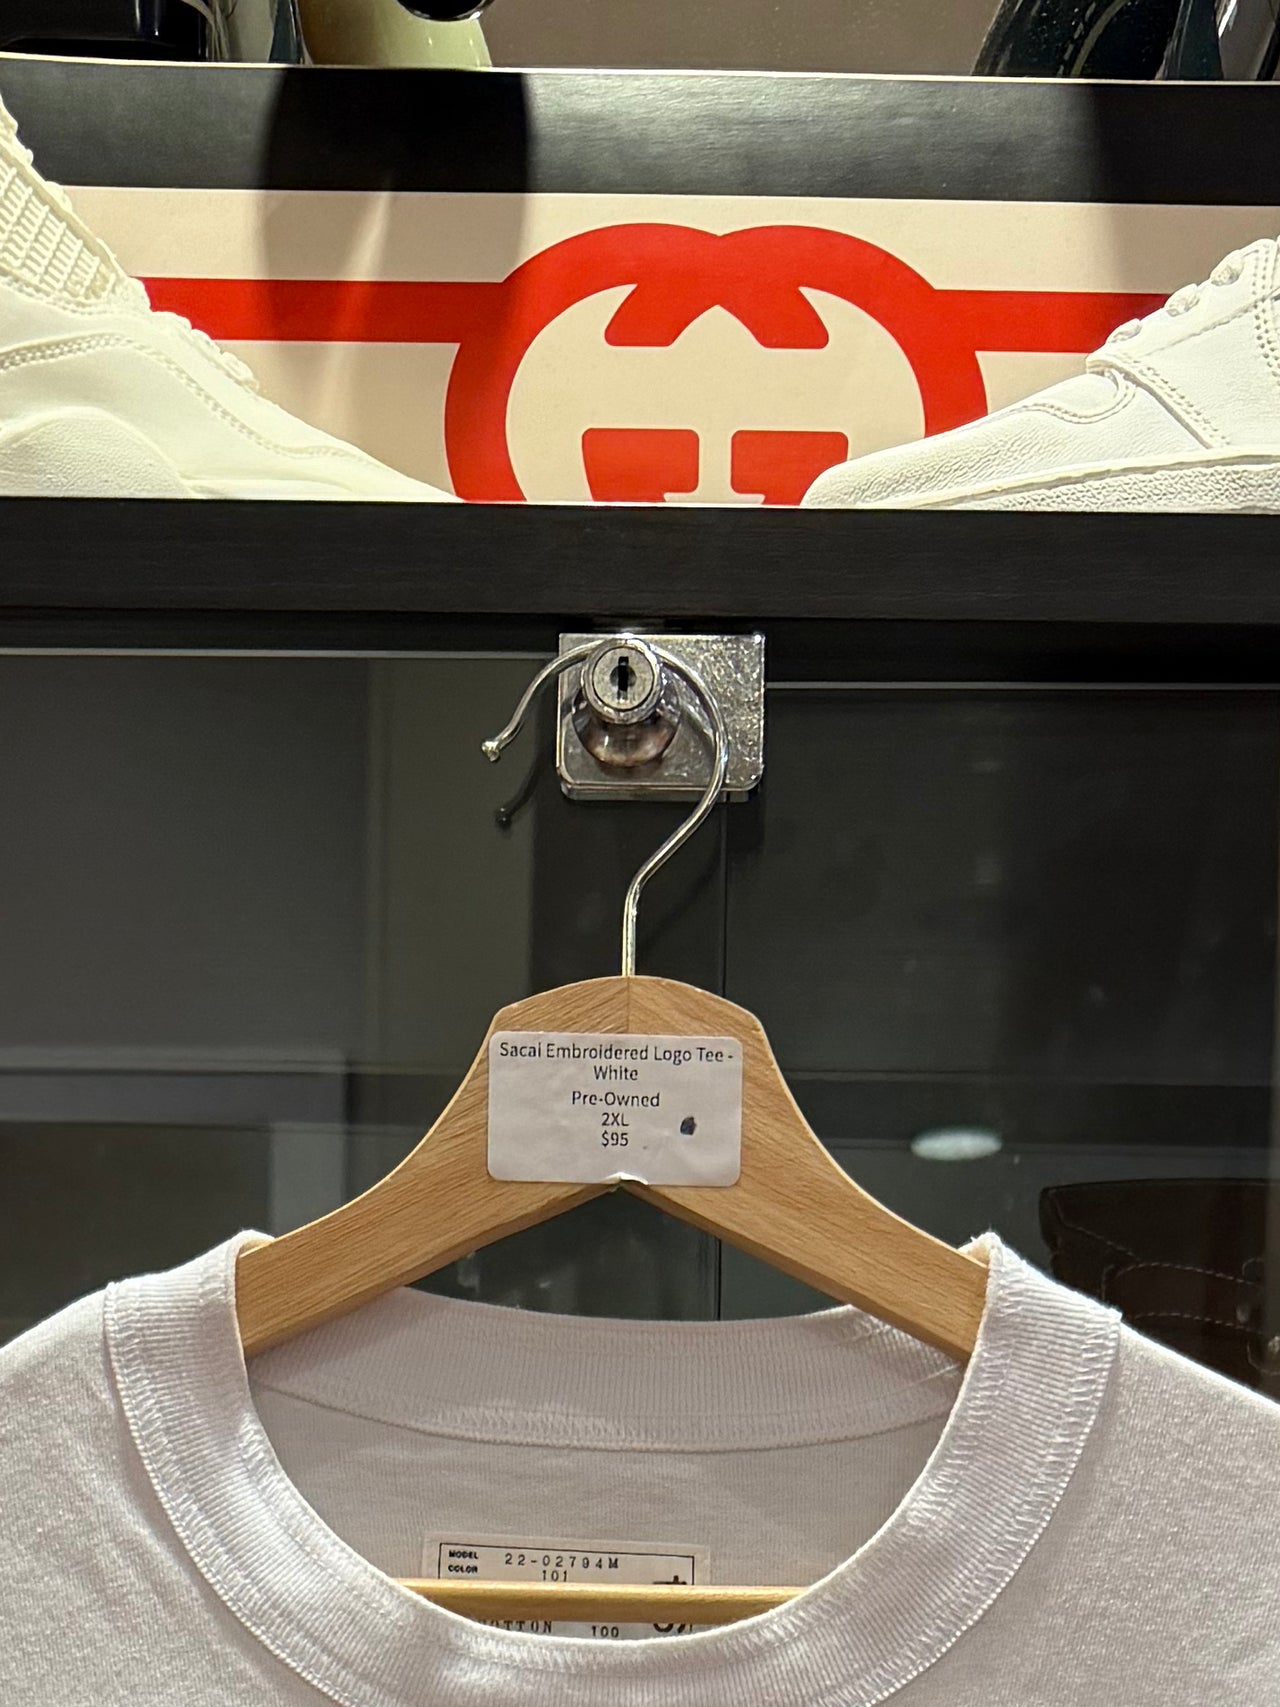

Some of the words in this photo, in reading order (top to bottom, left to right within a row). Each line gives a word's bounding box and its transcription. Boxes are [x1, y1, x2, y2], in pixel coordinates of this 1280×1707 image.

[500, 1042, 541, 1058] Sacai
[546, 1043, 648, 1061] Embroidered
[654, 1047, 692, 1065] Logo
[696, 1047, 724, 1062] Tee
[593, 1065, 639, 1081] White
[571, 1091, 661, 1107] Pre-Owned
[601, 1113, 630, 1127] 2XL
[601, 1131, 629, 1148] $95
[448, 1549, 479, 1560] MODEL
[448, 1564, 478, 1574] COLOR
[542, 1570, 568, 1582] 101
[591, 1626, 619, 1638] 100
